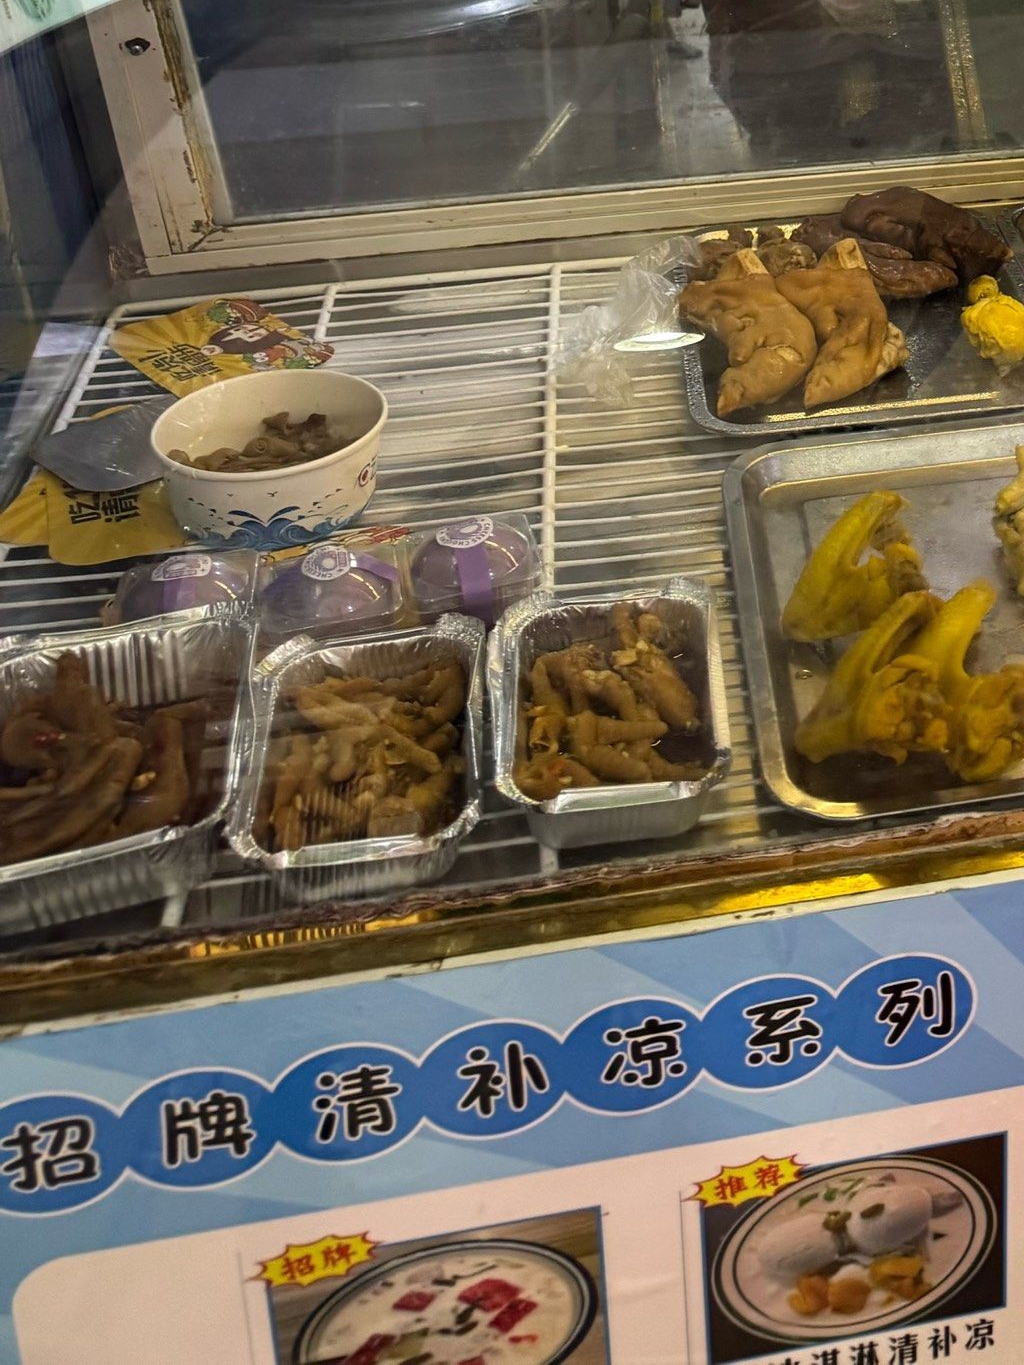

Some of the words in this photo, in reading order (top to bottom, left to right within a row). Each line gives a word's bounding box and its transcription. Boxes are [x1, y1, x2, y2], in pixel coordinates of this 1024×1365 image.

[0, 971, 954, 1192] 招牌清补凉系列
[713, 1162, 786, 1202] 推荐
[280, 1243, 357, 1282] 招牌
[767, 1318, 997, 1365] 淇淋清补凉
